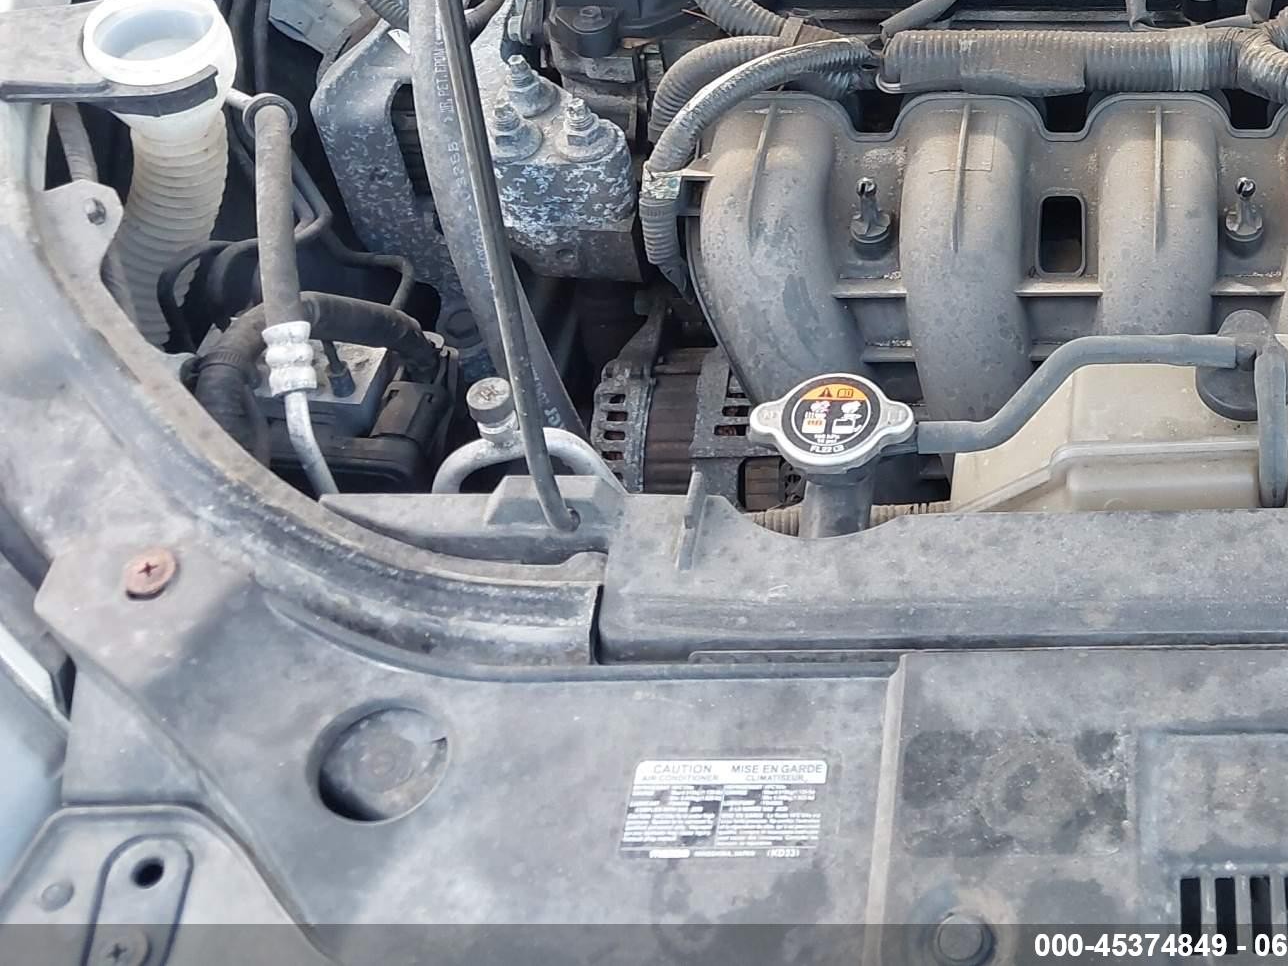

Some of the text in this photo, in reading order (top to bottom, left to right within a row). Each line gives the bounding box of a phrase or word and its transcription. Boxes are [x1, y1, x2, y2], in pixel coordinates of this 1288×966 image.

[653, 763, 713, 774] CAUTION
[731, 764, 824, 774] MISE EN GARDE
